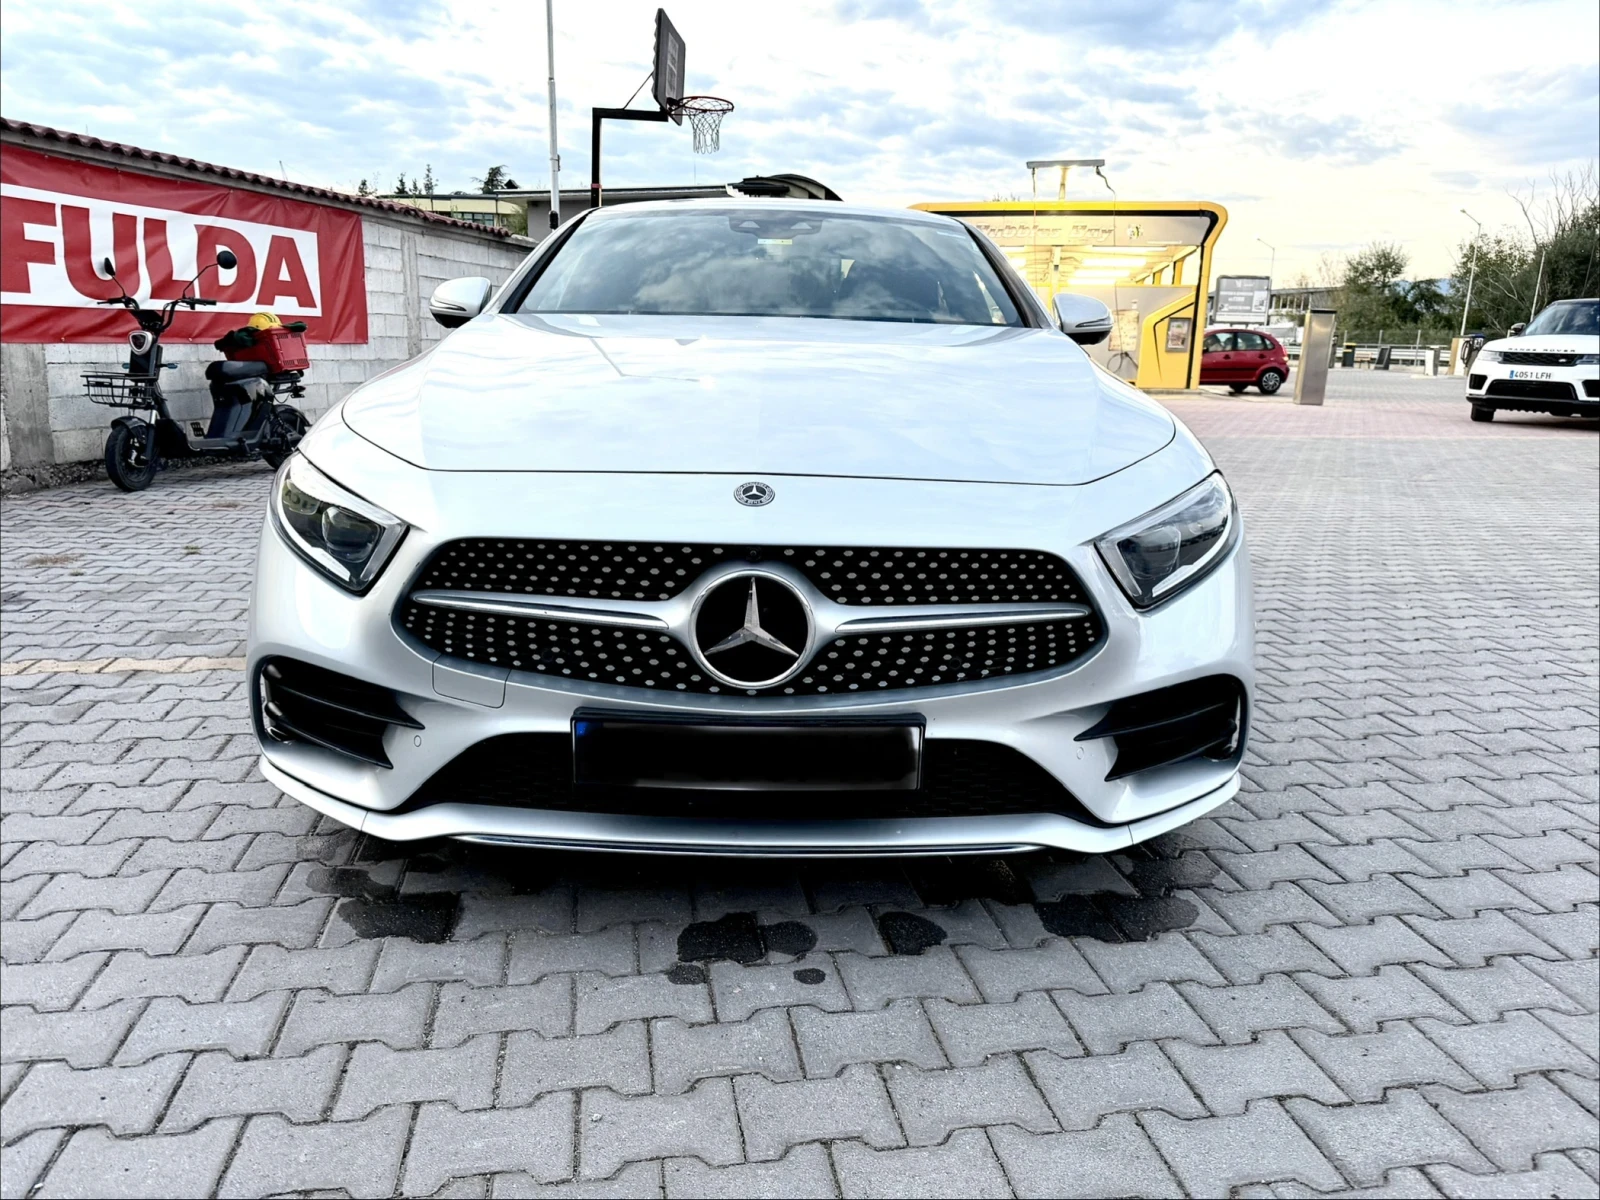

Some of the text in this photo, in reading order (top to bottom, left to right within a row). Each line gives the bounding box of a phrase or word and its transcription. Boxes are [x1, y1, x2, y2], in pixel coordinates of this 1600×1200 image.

[0, 196, 318, 308] FULDA
[1514, 370, 1552, 380] 4051 LFH
